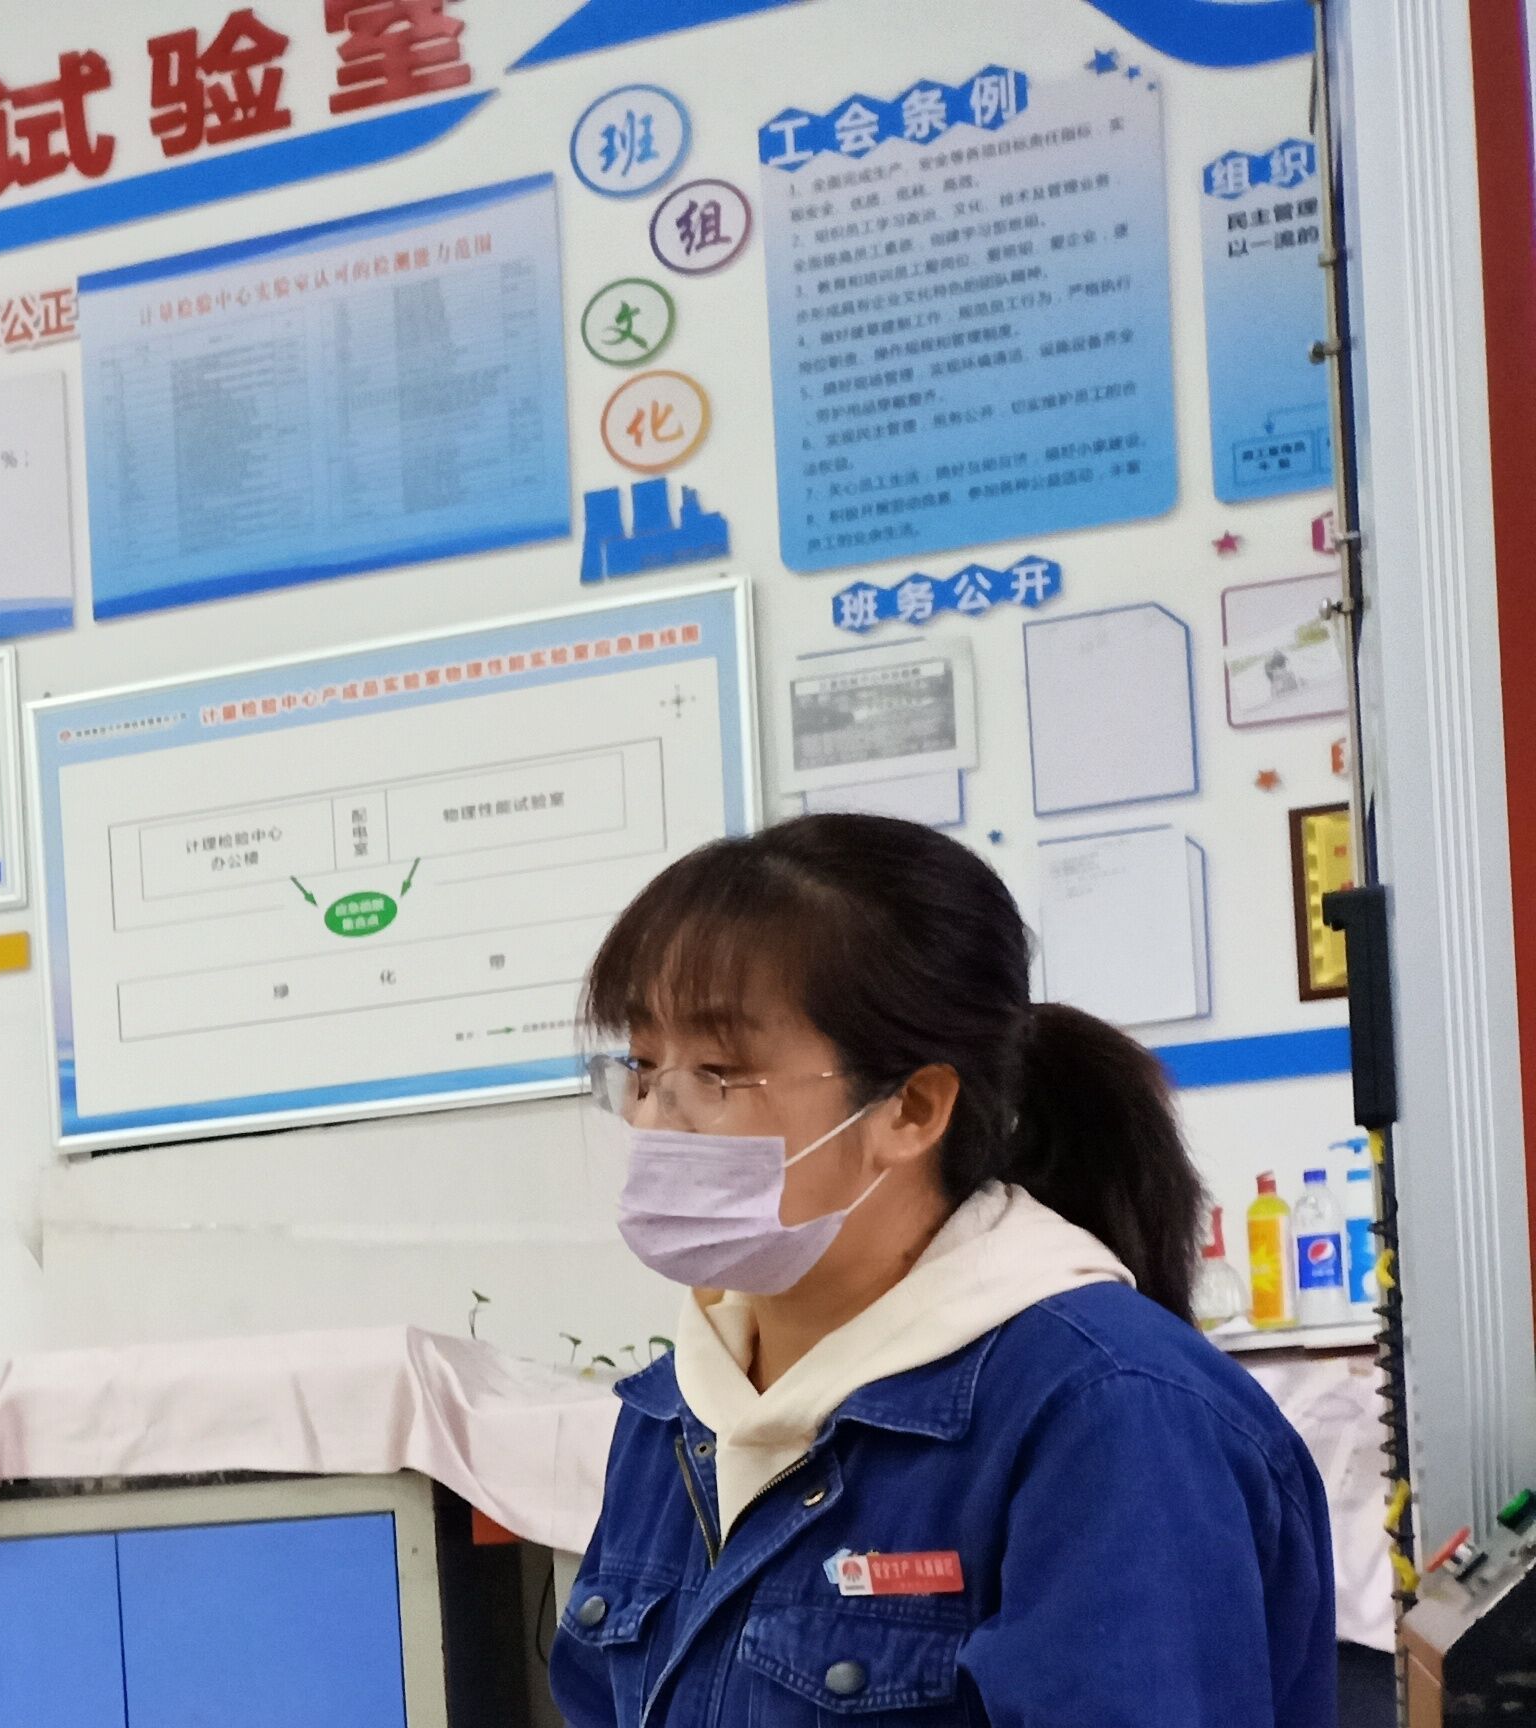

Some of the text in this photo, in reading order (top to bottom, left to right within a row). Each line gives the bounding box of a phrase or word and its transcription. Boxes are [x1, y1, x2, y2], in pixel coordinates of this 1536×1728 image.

[767, 68, 1019, 166] 工会条例
[1212, 144, 1316, 195] 组织
[840, 563, 1051, 629] 班务公开
